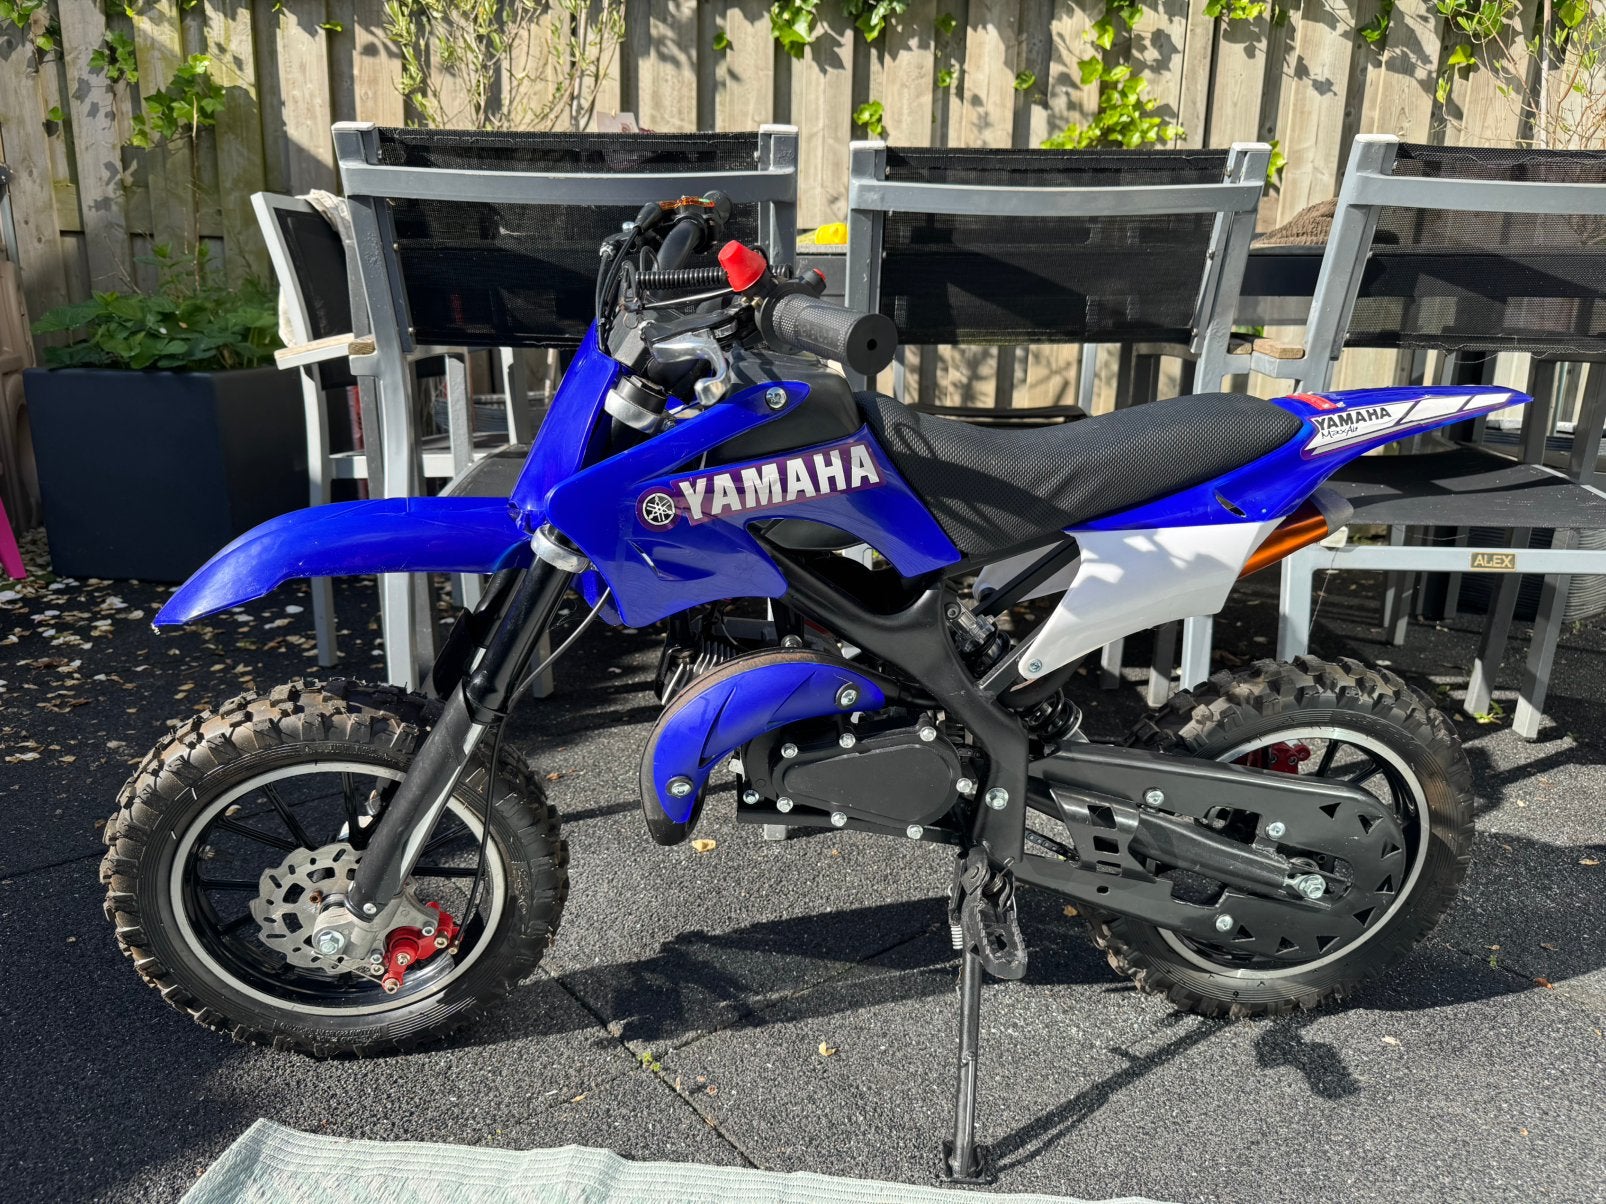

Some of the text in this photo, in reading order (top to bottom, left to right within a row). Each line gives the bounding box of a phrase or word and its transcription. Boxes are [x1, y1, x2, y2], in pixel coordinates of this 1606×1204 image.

[1314, 407, 1392, 431] YAMAHA
[679, 444, 880, 520] YAMAHA
[1473, 554, 1513, 568] ALEX
